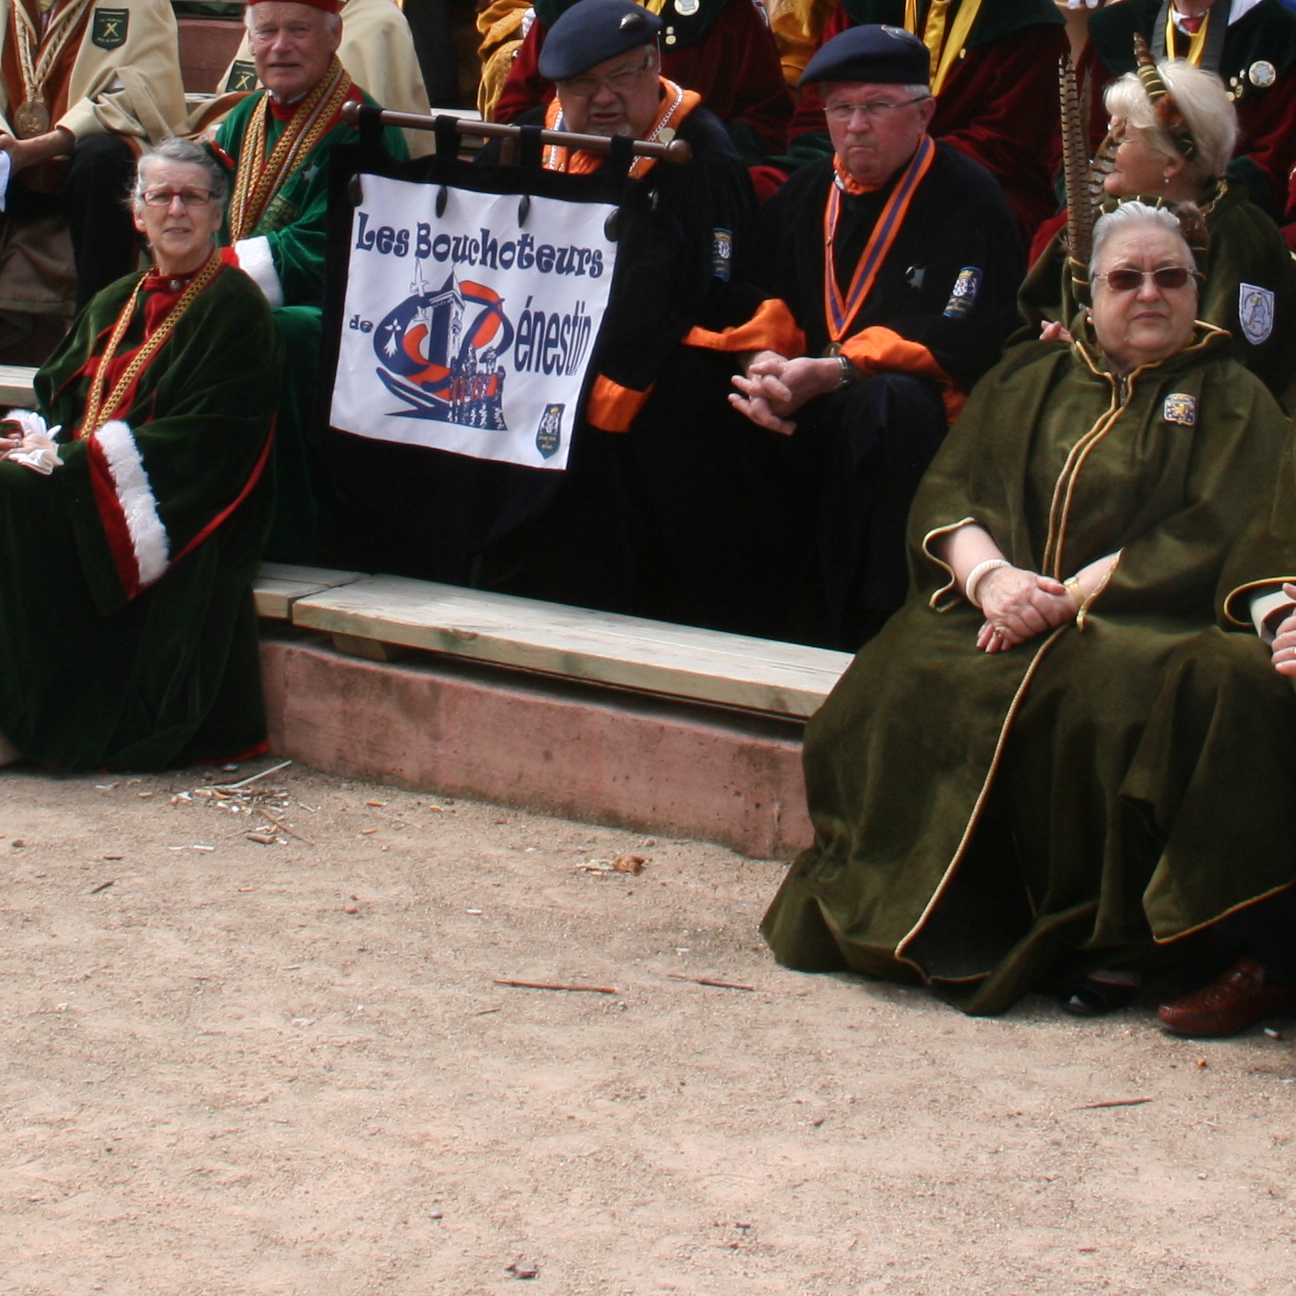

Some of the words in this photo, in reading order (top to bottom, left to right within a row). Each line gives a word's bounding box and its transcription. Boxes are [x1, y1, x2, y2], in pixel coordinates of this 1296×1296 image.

[355, 211, 410, 259] Les
[414, 220, 604, 279] Bouchoteurs
[349, 313, 374, 333] de
